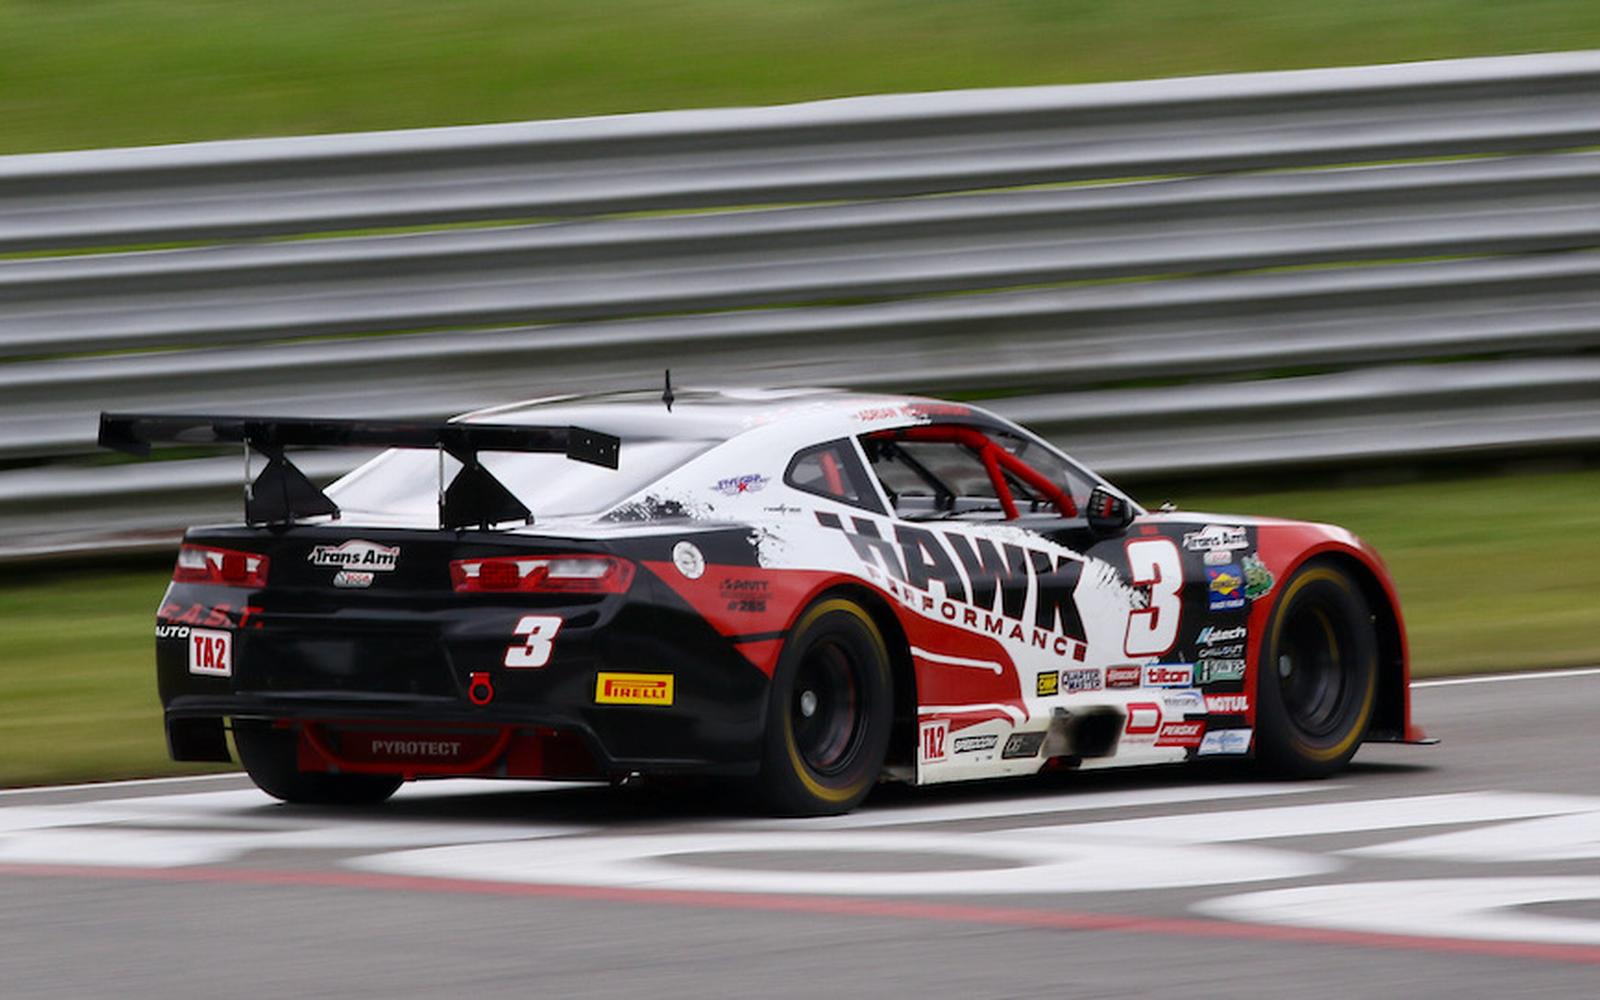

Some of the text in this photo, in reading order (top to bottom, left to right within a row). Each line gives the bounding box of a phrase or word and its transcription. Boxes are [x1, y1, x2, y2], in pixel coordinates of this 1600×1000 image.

[313, 547, 394, 564] Trans Am
[814, 511, 1088, 644] HAWK
[1124, 536, 1184, 658] 3
[194, 635, 226, 670] TA2
[503, 613, 564, 668] 3
[604, 679, 667, 699] PIRELLI
[371, 740, 461, 756] PYROTECT
[923, 726, 945, 760] TA2
